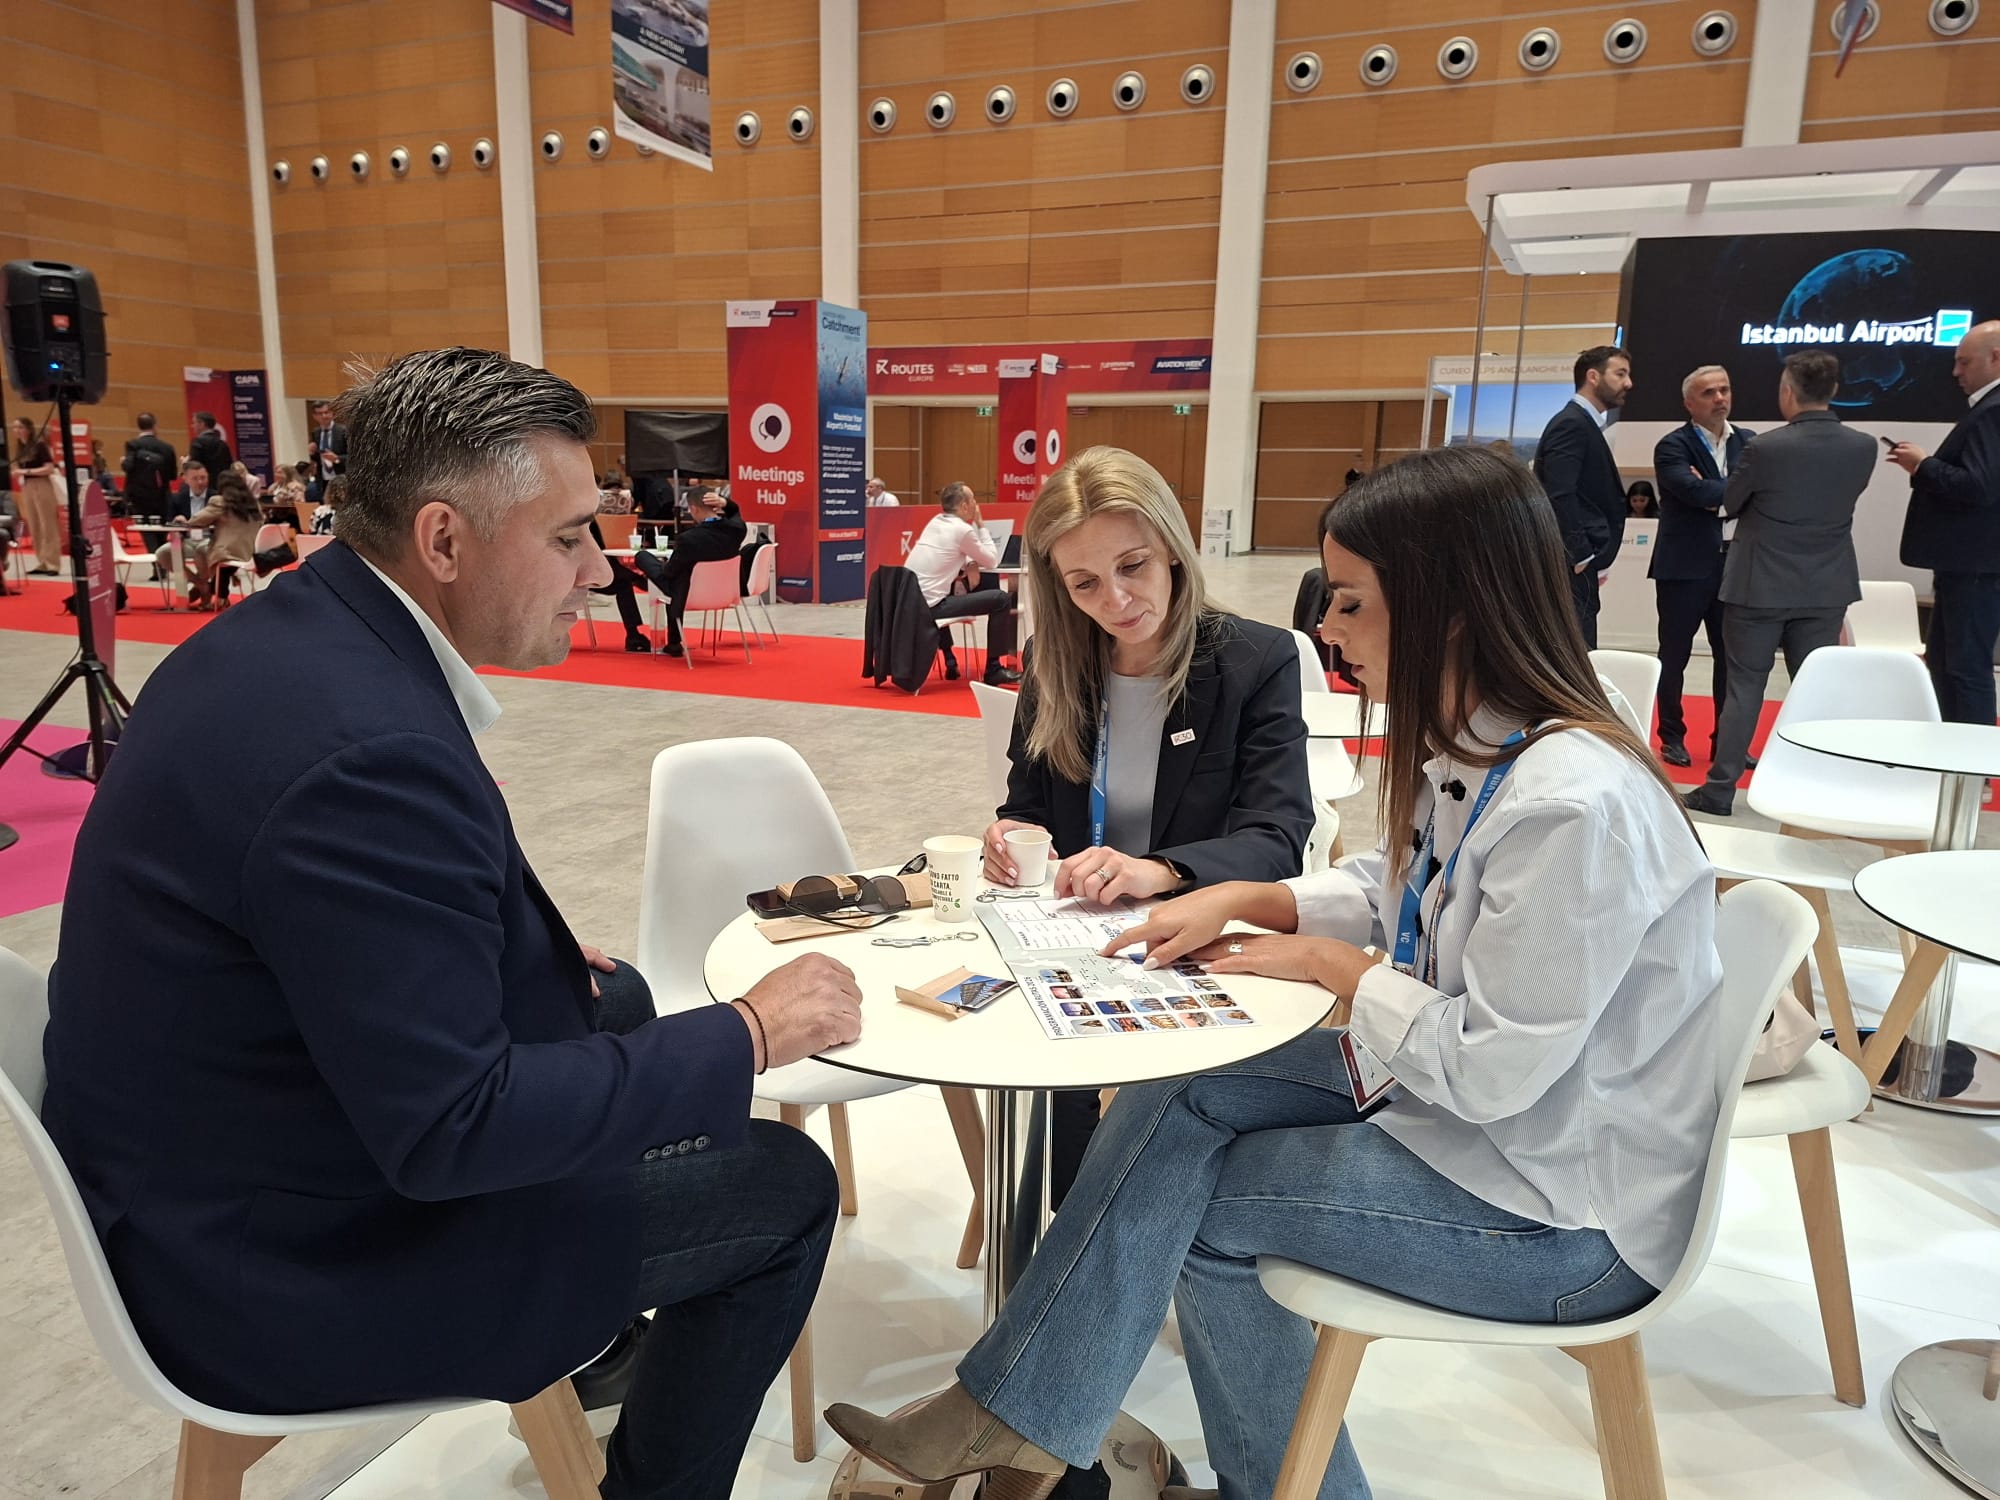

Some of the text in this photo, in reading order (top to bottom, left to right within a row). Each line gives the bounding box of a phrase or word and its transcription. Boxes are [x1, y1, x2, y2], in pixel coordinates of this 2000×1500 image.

[822, 317, 861, 336] Catchment
[1741, 318, 1935, 346] Istanbul Airport
[891, 364, 935, 375] ROUTES
[1440, 367, 1471, 375] CUNEO
[235, 375, 260, 385] CAPA
[738, 465, 805, 486] Meetings
[757, 489, 787, 505] Hub
[941, 873, 960, 881] FATTO
[1037, 1000, 1064, 1036] PROGRAMACIÓN
